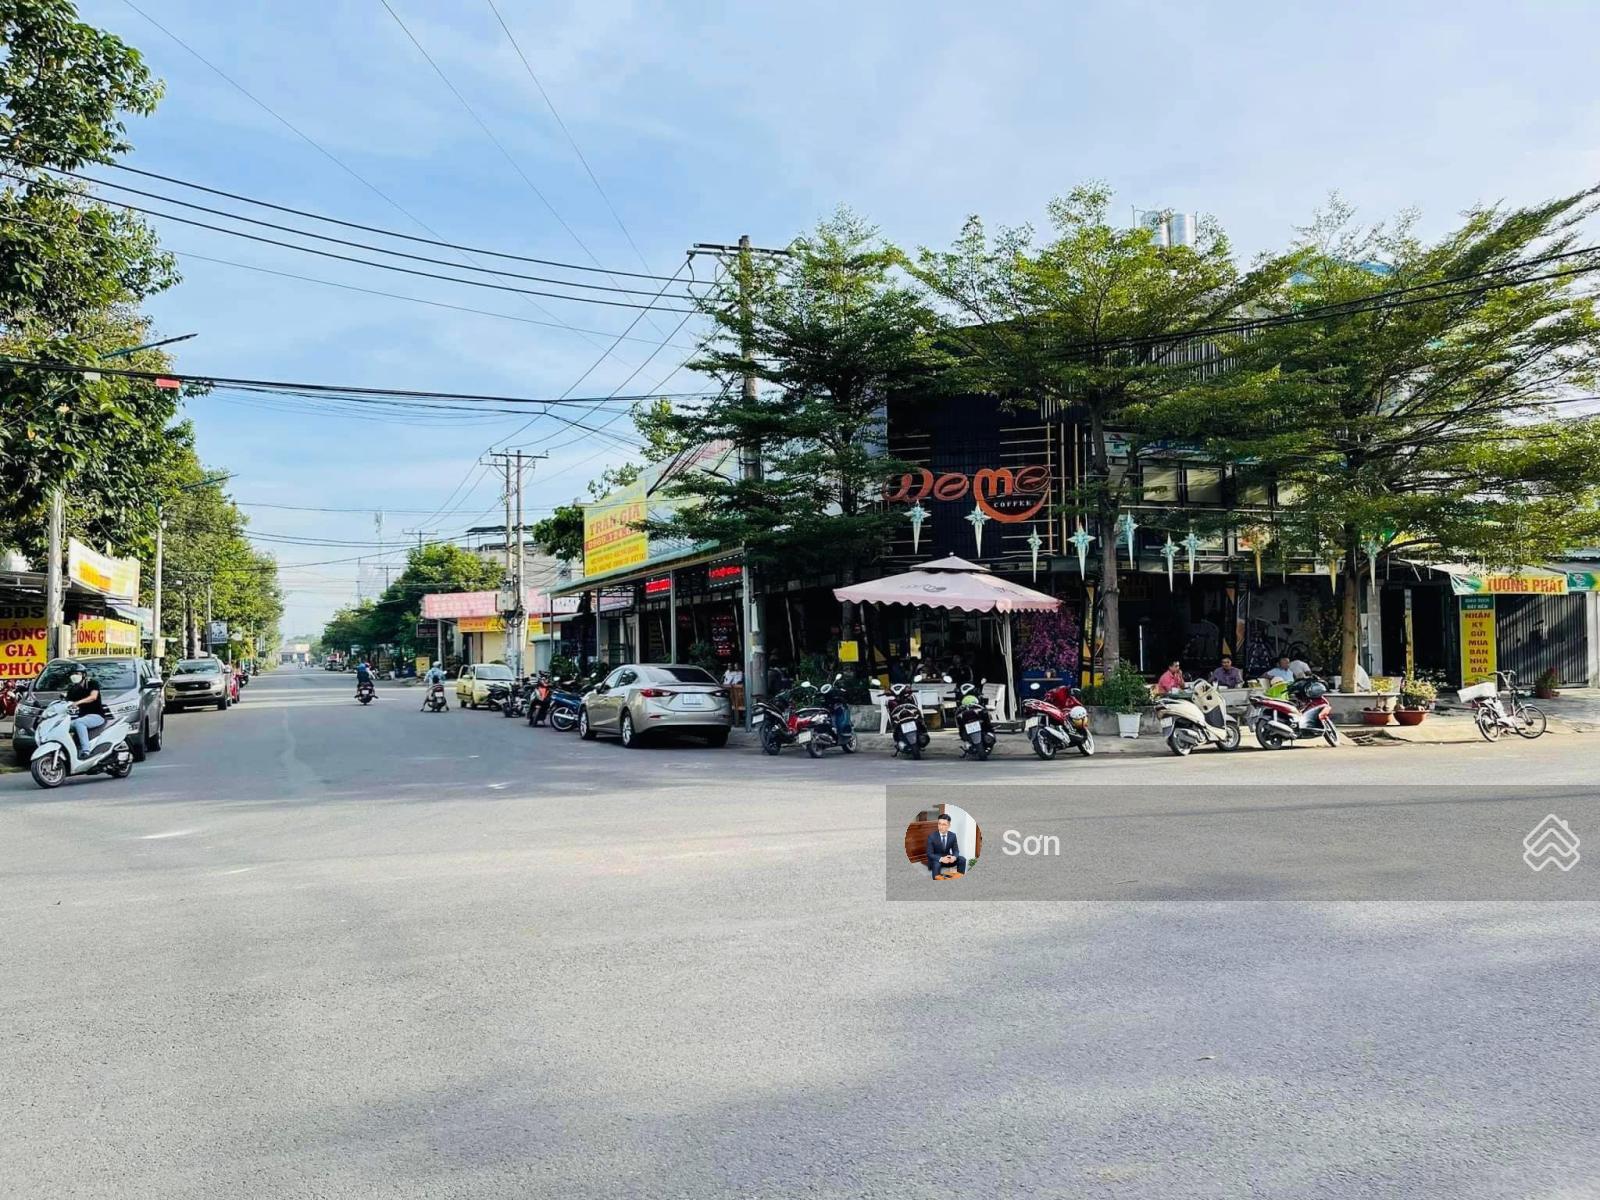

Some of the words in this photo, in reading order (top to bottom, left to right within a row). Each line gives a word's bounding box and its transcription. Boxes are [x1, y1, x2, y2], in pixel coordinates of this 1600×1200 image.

[993, 500, 1032, 508] COFFEE
[5, 644, 37, 656] GIA
[0, 659, 45, 675] PHÚC
